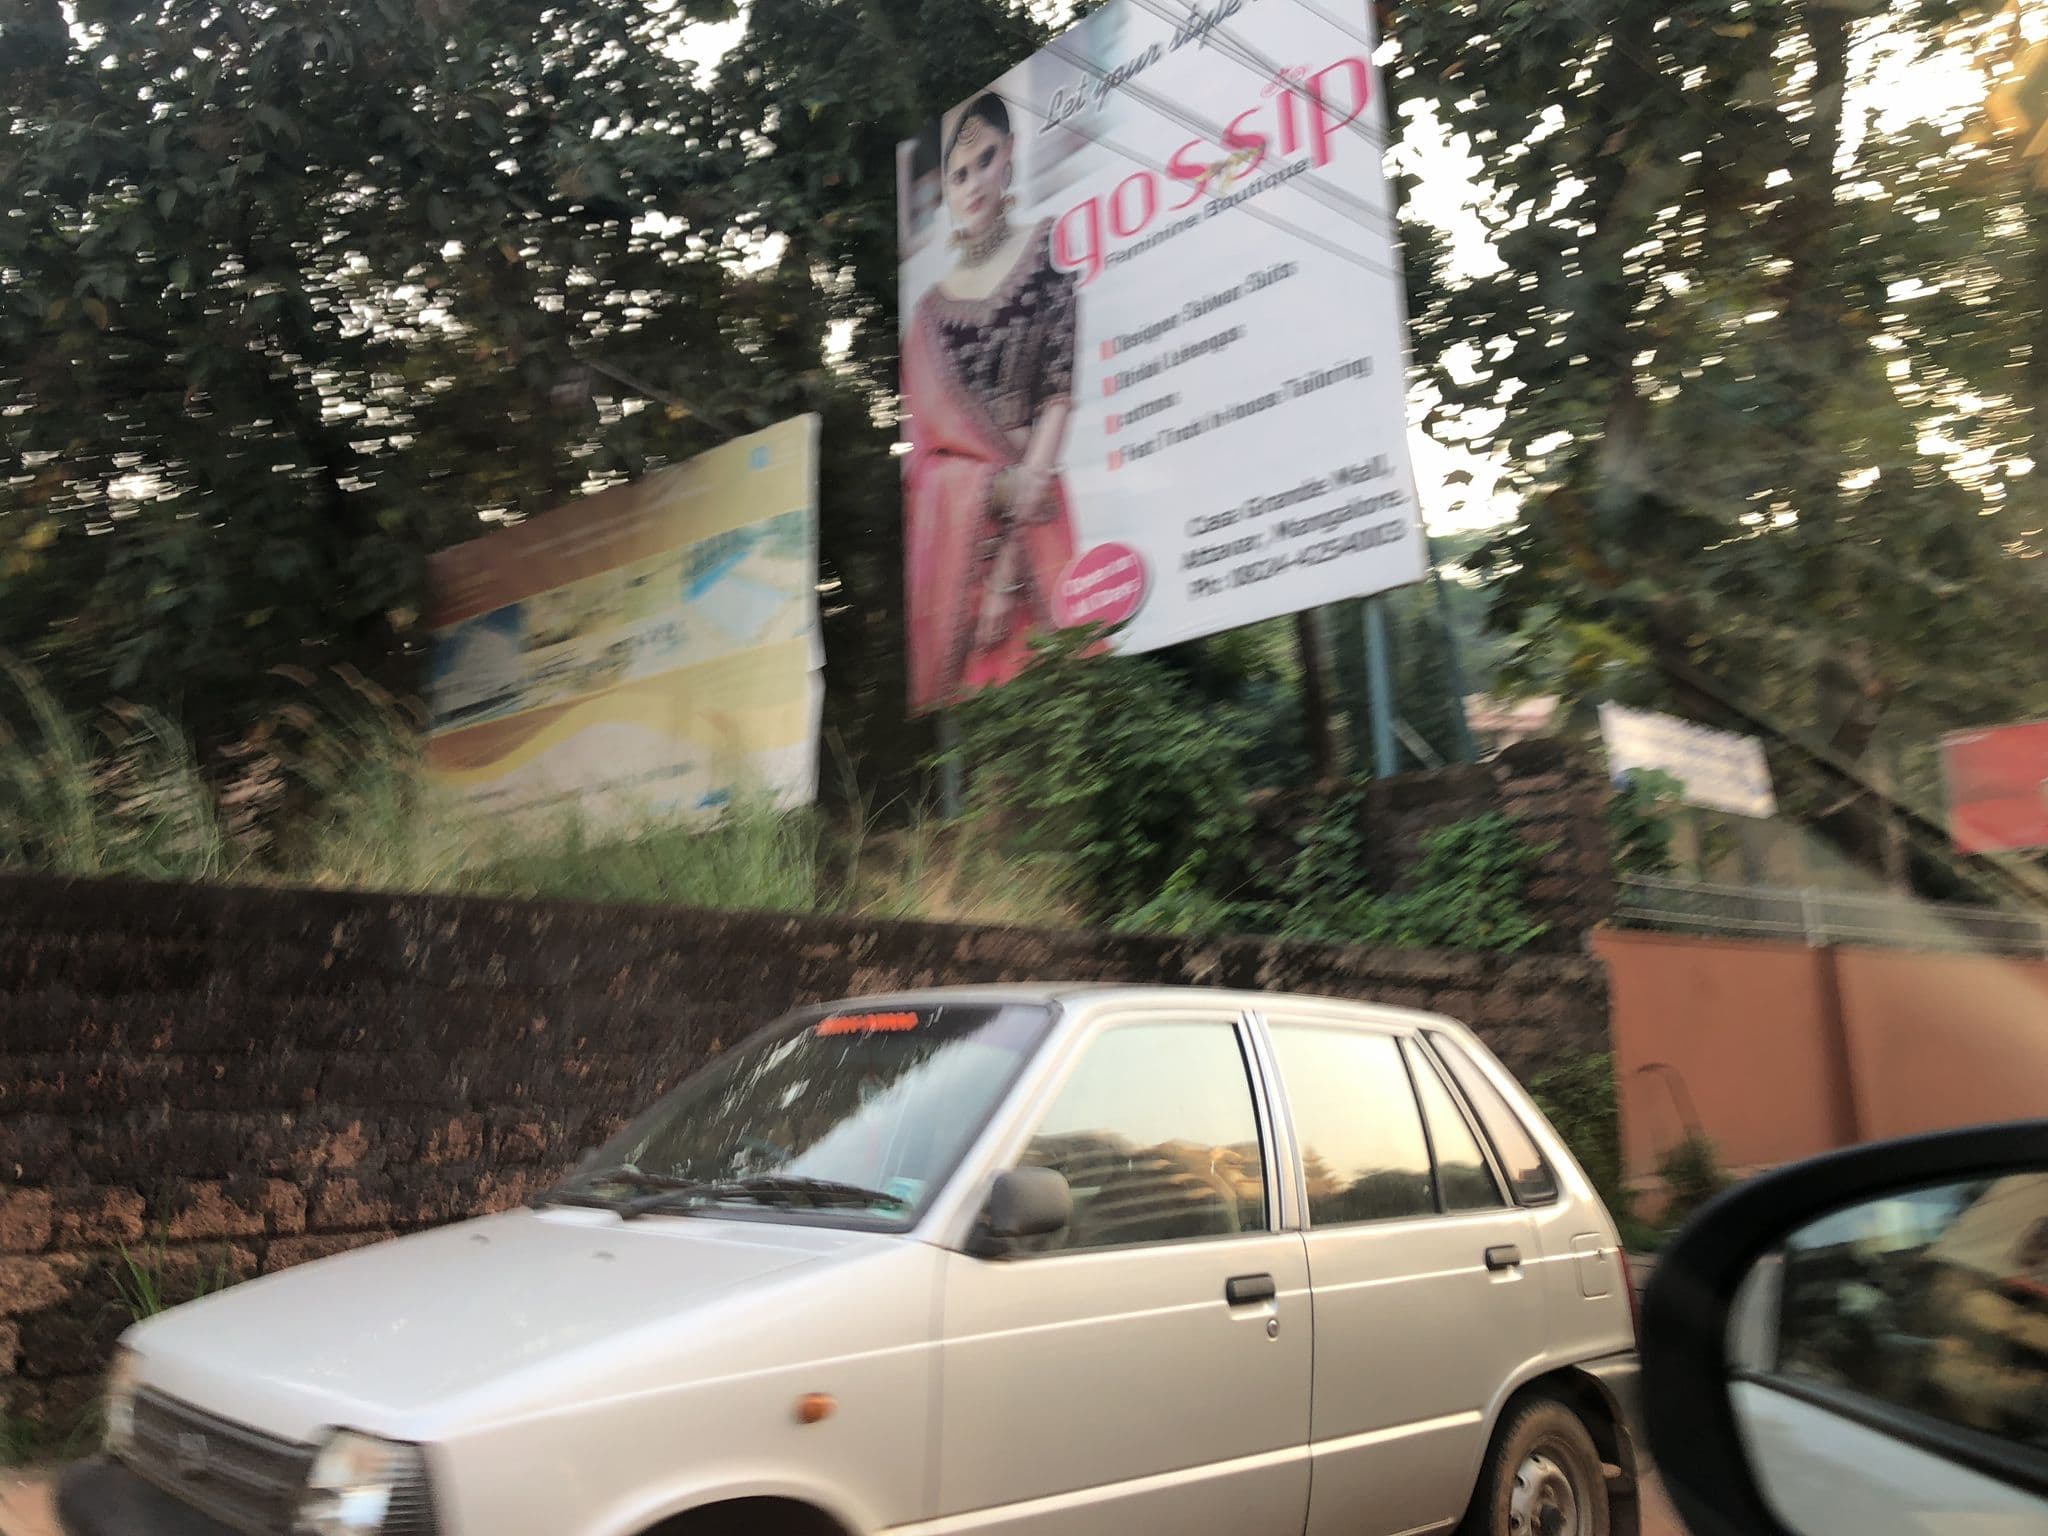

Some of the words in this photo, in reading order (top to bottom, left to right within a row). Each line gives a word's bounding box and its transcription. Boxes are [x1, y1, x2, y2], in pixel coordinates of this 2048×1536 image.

[1040, 73, 1088, 134] Let
[1094, 43, 1163, 112] your
[1052, 57, 1370, 288] gossip
[1104, 213, 1200, 268] Feminine
[1203, 157, 1312, 221] Boutique
